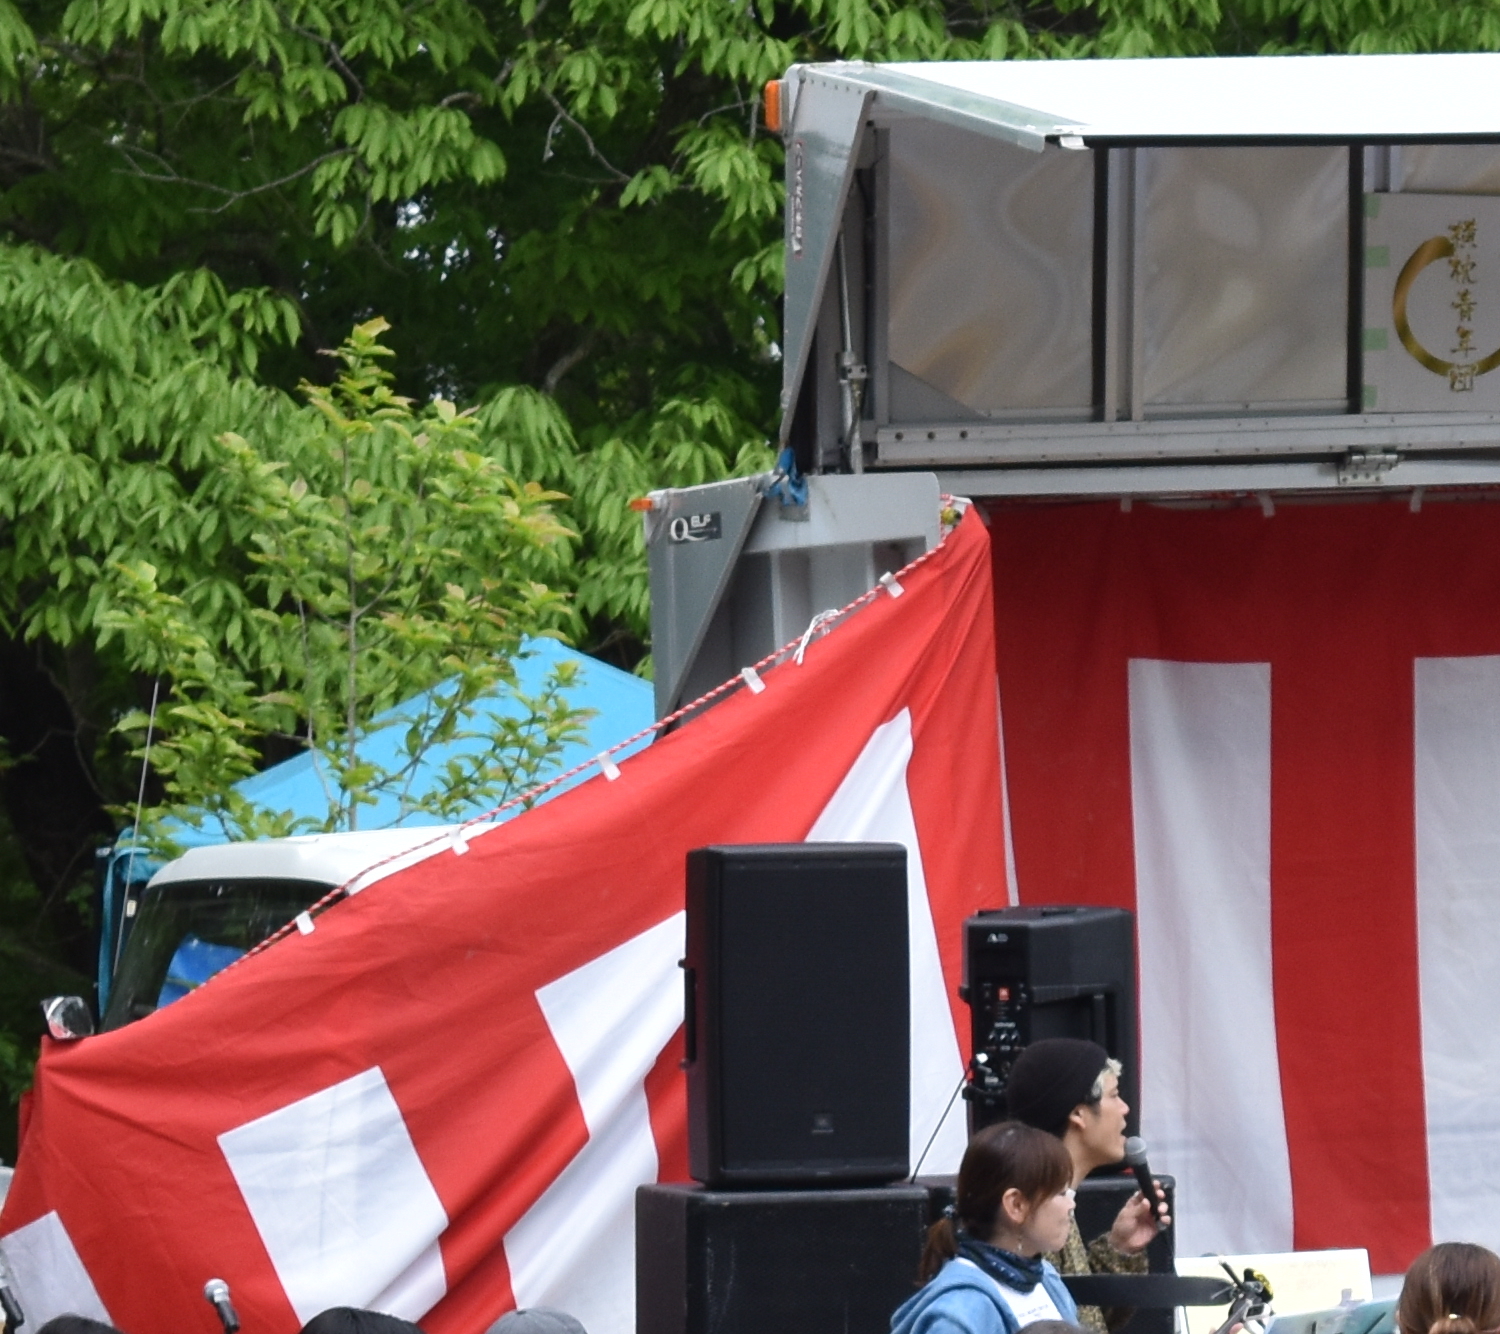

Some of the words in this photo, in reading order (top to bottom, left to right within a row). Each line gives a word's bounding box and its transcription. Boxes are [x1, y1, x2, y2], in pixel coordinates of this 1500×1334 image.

[1448, 218, 1479, 394] 横枕青年団
